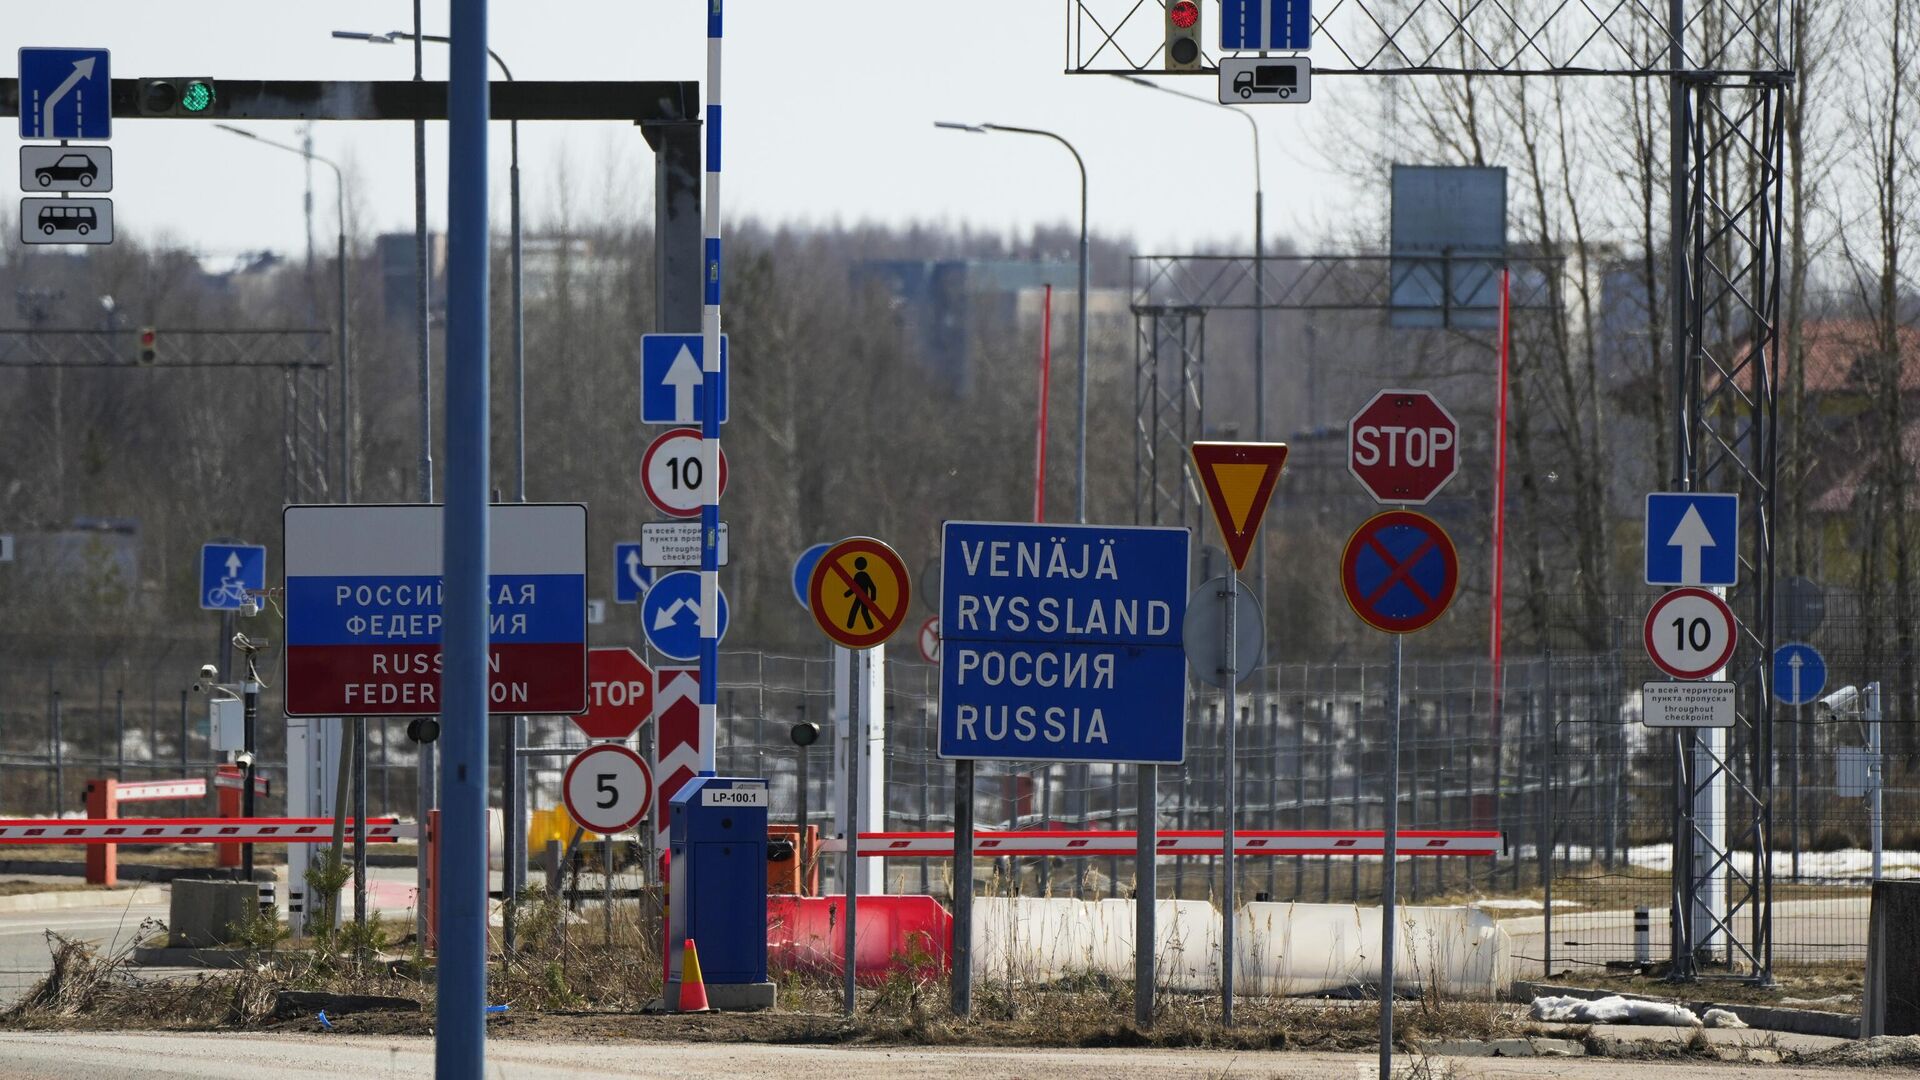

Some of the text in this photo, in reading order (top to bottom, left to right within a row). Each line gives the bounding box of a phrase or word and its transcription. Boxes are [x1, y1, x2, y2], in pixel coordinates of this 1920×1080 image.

[1355, 425, 1453, 468] STOP
[665, 456, 703, 490] 10
[662, 545, 702, 553] througho
[960, 537, 1118, 580] VENÄJÄ
[346, 614, 527, 639] ФЕДЕРИЯ
[957, 595, 1171, 636] RYSSLAND
[1671, 617, 1712, 652] 10
[372, 653, 500, 675] RUSSN
[957, 649, 1115, 689] РОССИЯ
[345, 682, 528, 705] FEDERON
[588, 681, 645, 706] TOP
[1658, 686, 1679, 694] всей
[1682, 687, 1734, 695] территории
[1664, 705, 1714, 713] throughout
[1664, 713, 1714, 722] checkpoint
[956, 704, 1109, 744] RUSSIA
[596, 773, 619, 809] 5
[712, 792, 756, 803] LP-100.1
